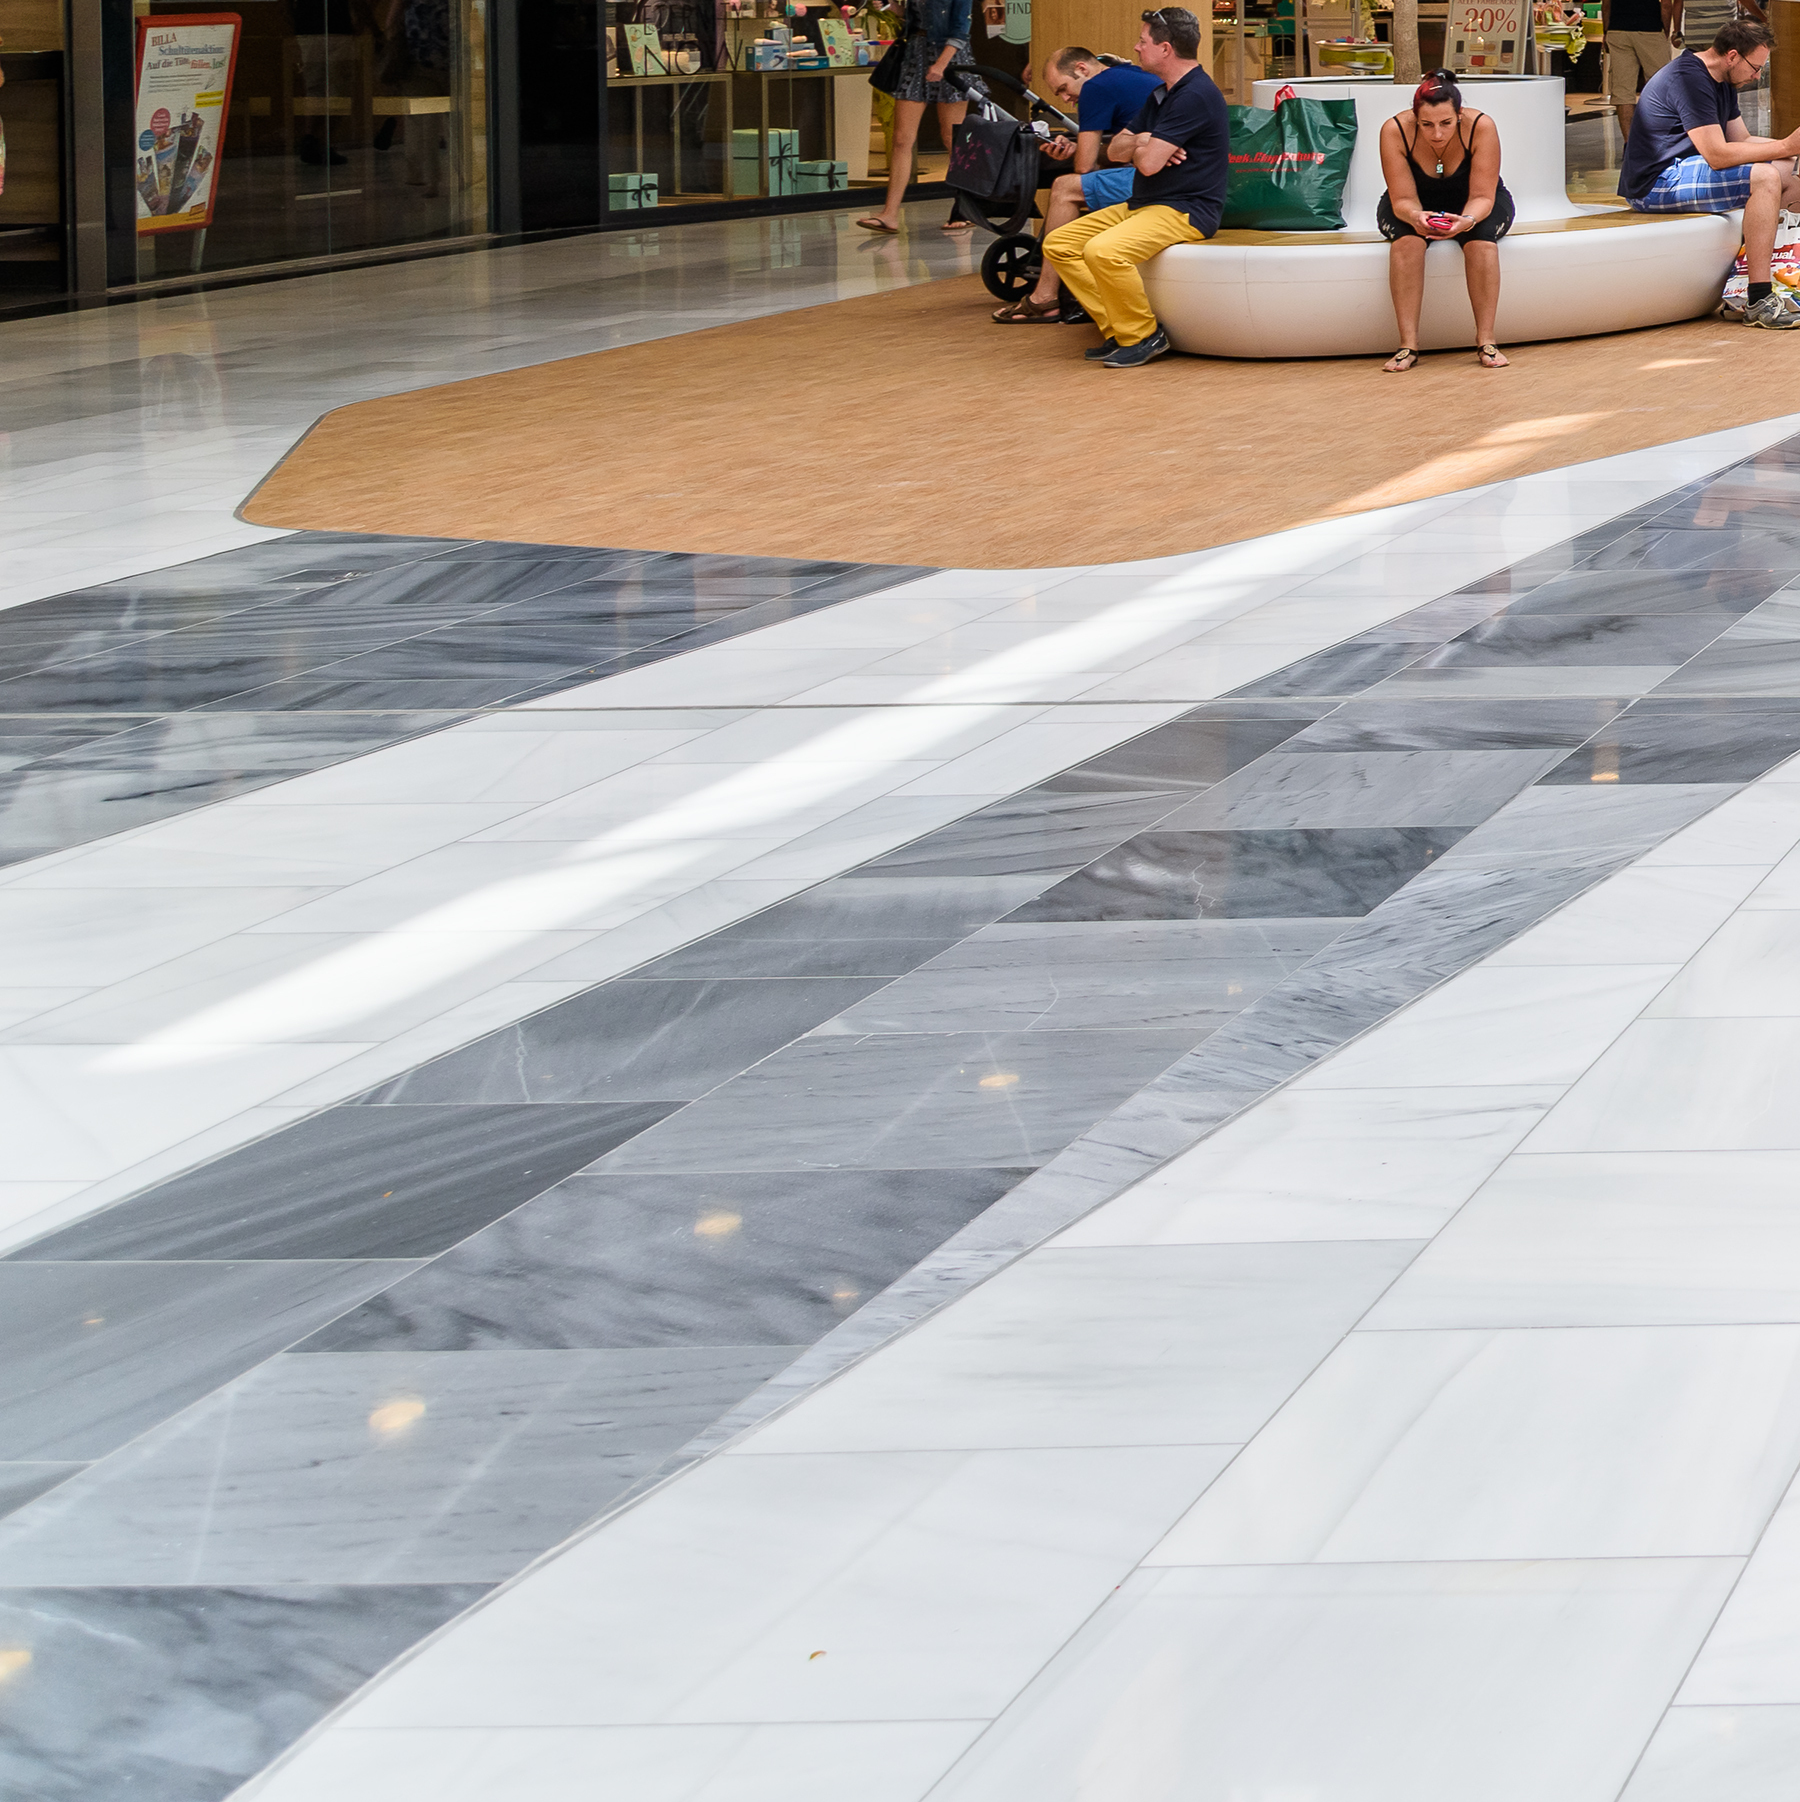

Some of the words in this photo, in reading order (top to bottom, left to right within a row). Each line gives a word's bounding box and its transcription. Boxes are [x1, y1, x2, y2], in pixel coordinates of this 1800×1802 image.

[1455, 7, 1517, 33] -20%
[151, 32, 177, 47] BILLA
[145, 59, 162, 71] Auf
[162, 59, 173, 68] die
